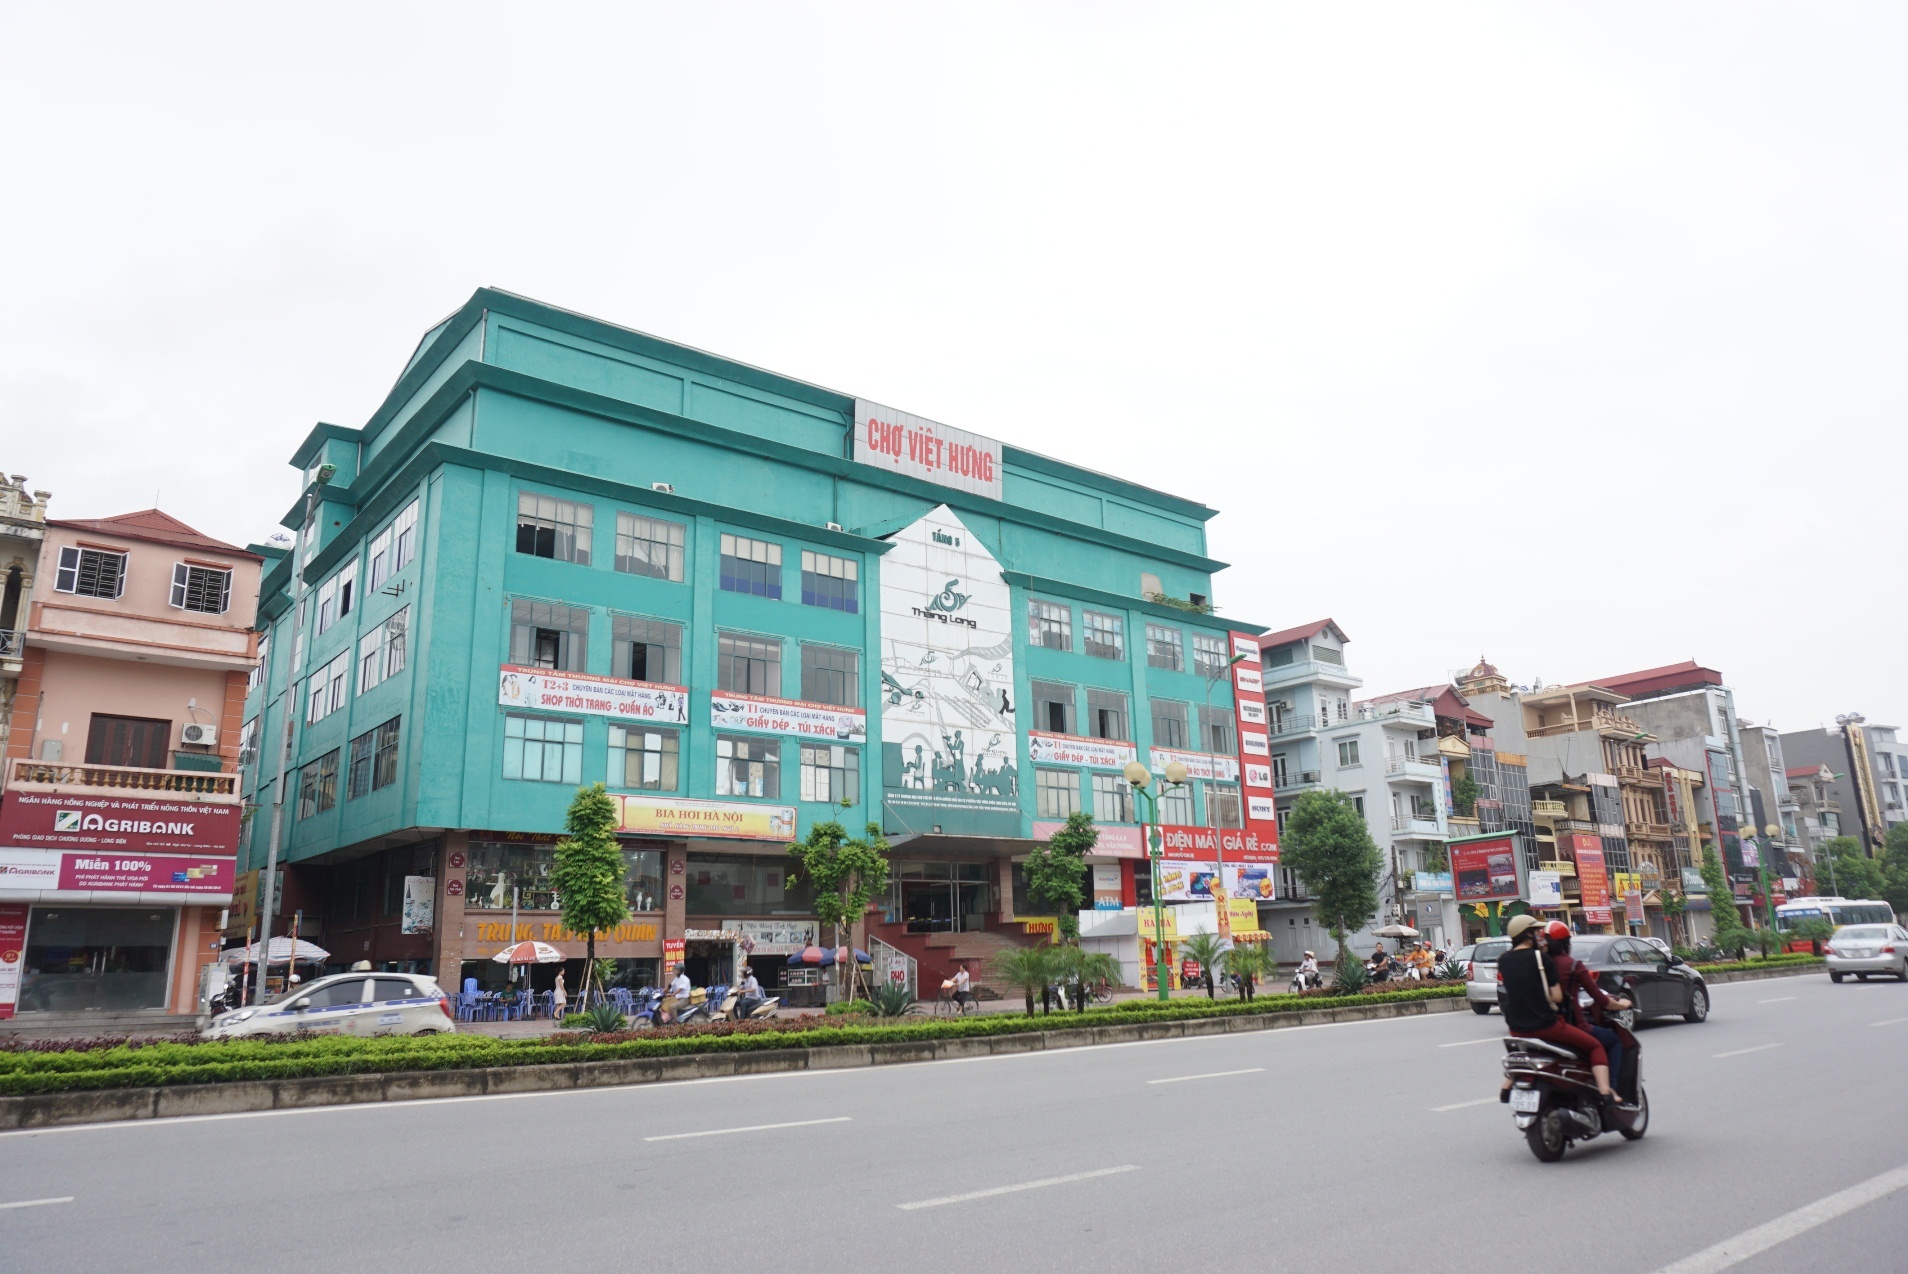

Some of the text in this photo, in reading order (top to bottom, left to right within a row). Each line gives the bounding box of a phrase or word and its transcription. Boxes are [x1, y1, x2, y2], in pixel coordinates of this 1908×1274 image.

[868, 418, 993, 482] CHỢ VIỆT HƯNG
[955, 538, 960, 547] 5
[950, 614, 976, 629] Long
[568, 674, 600, 682] THƯƠNG
[542, 680, 568, 692] T2+3
[572, 684, 592, 692] CHUYÊN
[604, 687, 614, 696] CÁC
[541, 694, 563, 706] SHOP
[565, 695, 584, 708] THỜI
[586, 698, 612, 712] TRANG
[642, 703, 654, 716] ÁO
[772, 718, 790, 730] DÉP
[798, 720, 811, 734] TÚI
[814, 723, 836, 736] XÁCH
[1072, 752, 1083, 763] DÉP
[1090, 754, 1098, 764] TÚI
[1101, 756, 1116, 766] XÁCH
[1259, 772, 1268, 780] LG
[42, 797, 62, 806] HÀNG
[64, 798, 84, 806] NÔNG
[85, 800, 110, 809] NGHIỆP
[111, 800, 120, 808] VÀ
[141, 802, 158, 810] TRIỂN
[200, 807, 212, 815] VIỆT
[656, 809, 743, 824] BIA HƠI HÀ NỘI
[1166, 830, 1192, 851] ĐIỆN
[1223, 832, 1244, 851] GIÁ
[1246, 832, 1258, 851] RẺ
[9, 868, 54, 876] AGRIBANK
[75, 858, 151, 872] Miễn 100%
[1098, 896, 1119, 906] ATM
[1029, 922, 1054, 934] HƯNG
